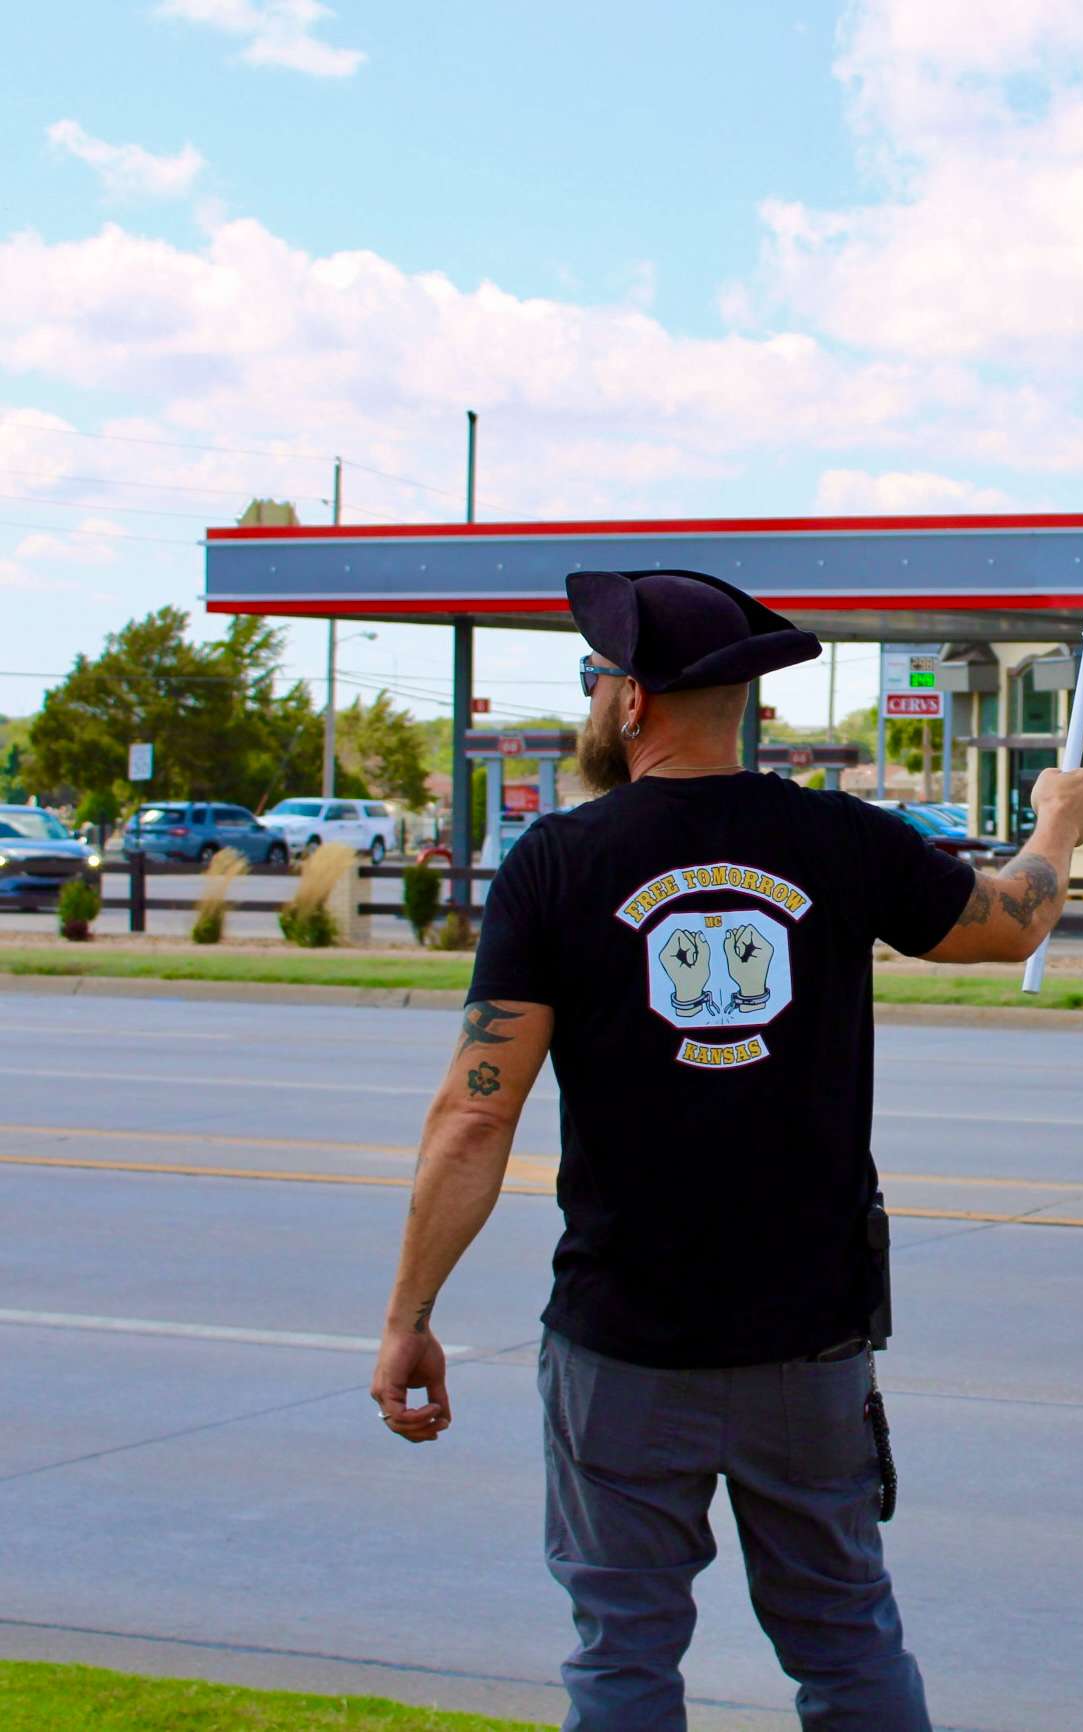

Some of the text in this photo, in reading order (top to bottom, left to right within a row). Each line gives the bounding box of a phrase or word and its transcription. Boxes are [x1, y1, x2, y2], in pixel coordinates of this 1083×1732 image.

[889, 698, 938, 711] CERVS
[624, 866, 806, 923] FREE TOMORROW
[683, 1040, 761, 1064] KANSAS
